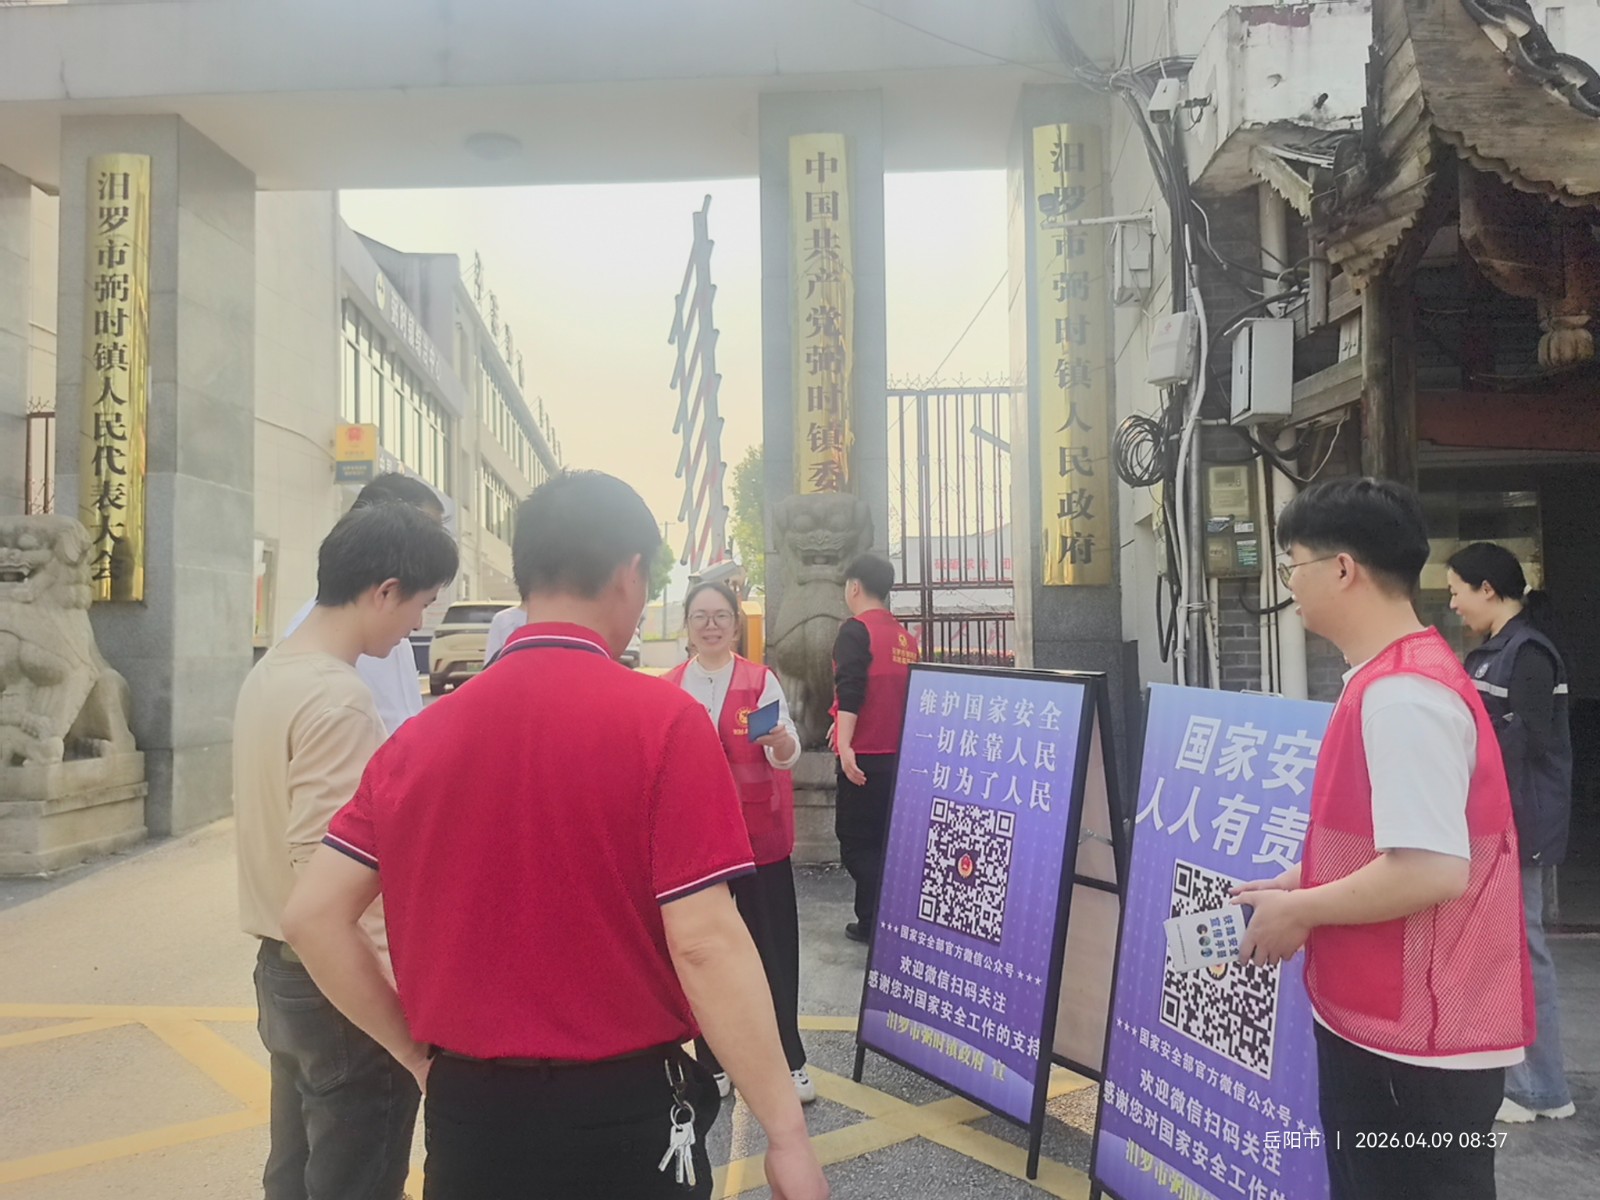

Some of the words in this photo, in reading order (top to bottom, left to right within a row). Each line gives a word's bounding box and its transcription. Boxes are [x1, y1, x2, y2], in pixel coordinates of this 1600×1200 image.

[803, 151, 843, 493] 中国共产党弼时镇委
[1050, 142, 1096, 565] 汨罗市弼时镇人民政府
[91, 171, 130, 582] 汨罗市弼时镇人民代表大会
[915, 725, 1057, 772] 一切依靠人民
[919, 688, 1063, 732] 维护国家安全
[910, 762, 1053, 812] 一切为了人民
[1135, 776, 1311, 871] 人人有责
[899, 956, 1007, 1014] 欢迎微信扫码关注
[900, 925, 1015, 979] 国家安全部官方微信公众号
[867, 970, 1040, 1060] 感谢您对国家安全工作的支持
[1139, 1027, 1292, 1127] 国家安全部官方微信公众号
[1139, 1068, 1282, 1176] 欢迎微信扫码关注
